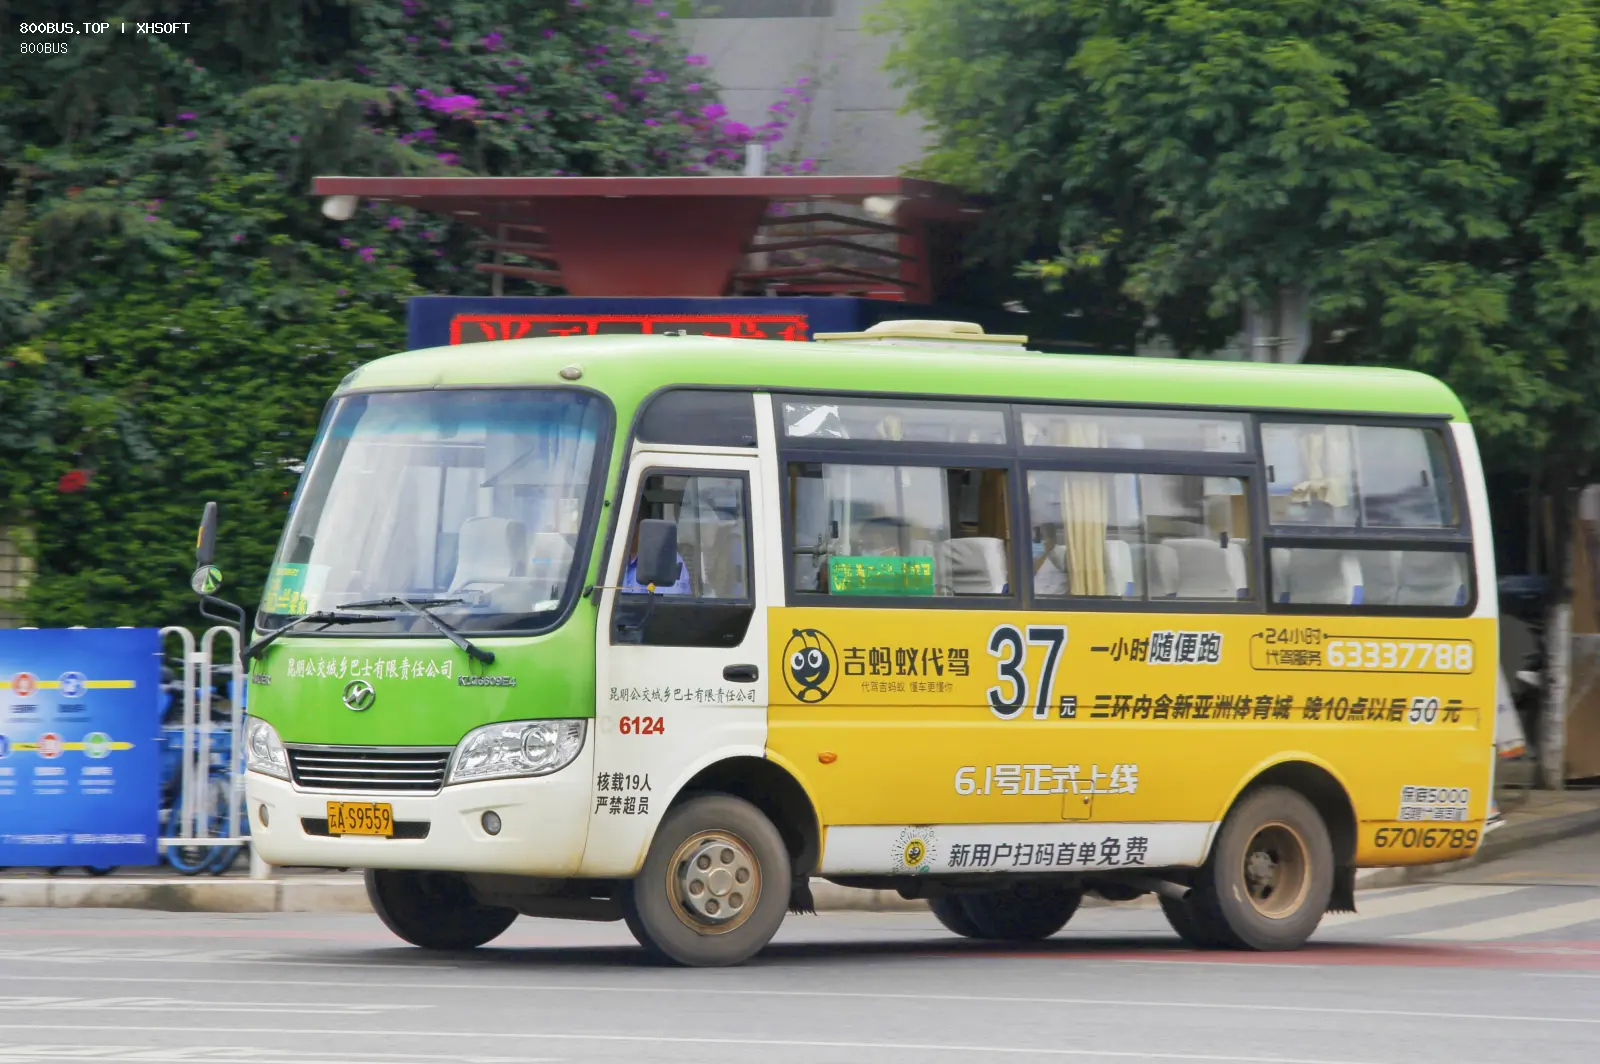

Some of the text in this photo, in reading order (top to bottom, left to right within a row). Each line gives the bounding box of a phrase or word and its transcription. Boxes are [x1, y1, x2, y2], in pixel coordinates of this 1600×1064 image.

[1091, 631, 1223, 664] 一小时随便跑
[1265, 627, 1321, 645] 24小时
[843, 647, 970, 677] 吉蚂蚁代驾
[1265, 649, 1322, 666] 代驾服务
[1327, 641, 1473, 670] 63337788
[287, 657, 453, 681] 昆明公交城乡巴士有限责任公司
[986, 623, 1068, 720] 37
[609, 687, 756, 703] 昆明公交城乡巴士有限责任公司
[1090, 695, 1293, 720] 三环内含新亚洲体育城
[619, 716, 665, 735] 6124
[597, 772, 652, 792] 核载19人
[954, 764, 1139, 795] 6.1号正式上线
[595, 796, 649, 815] 严禁超员
[1374, 827, 1478, 849] 67016789
[948, 836, 1149, 867] 新用户扫码首单免费
